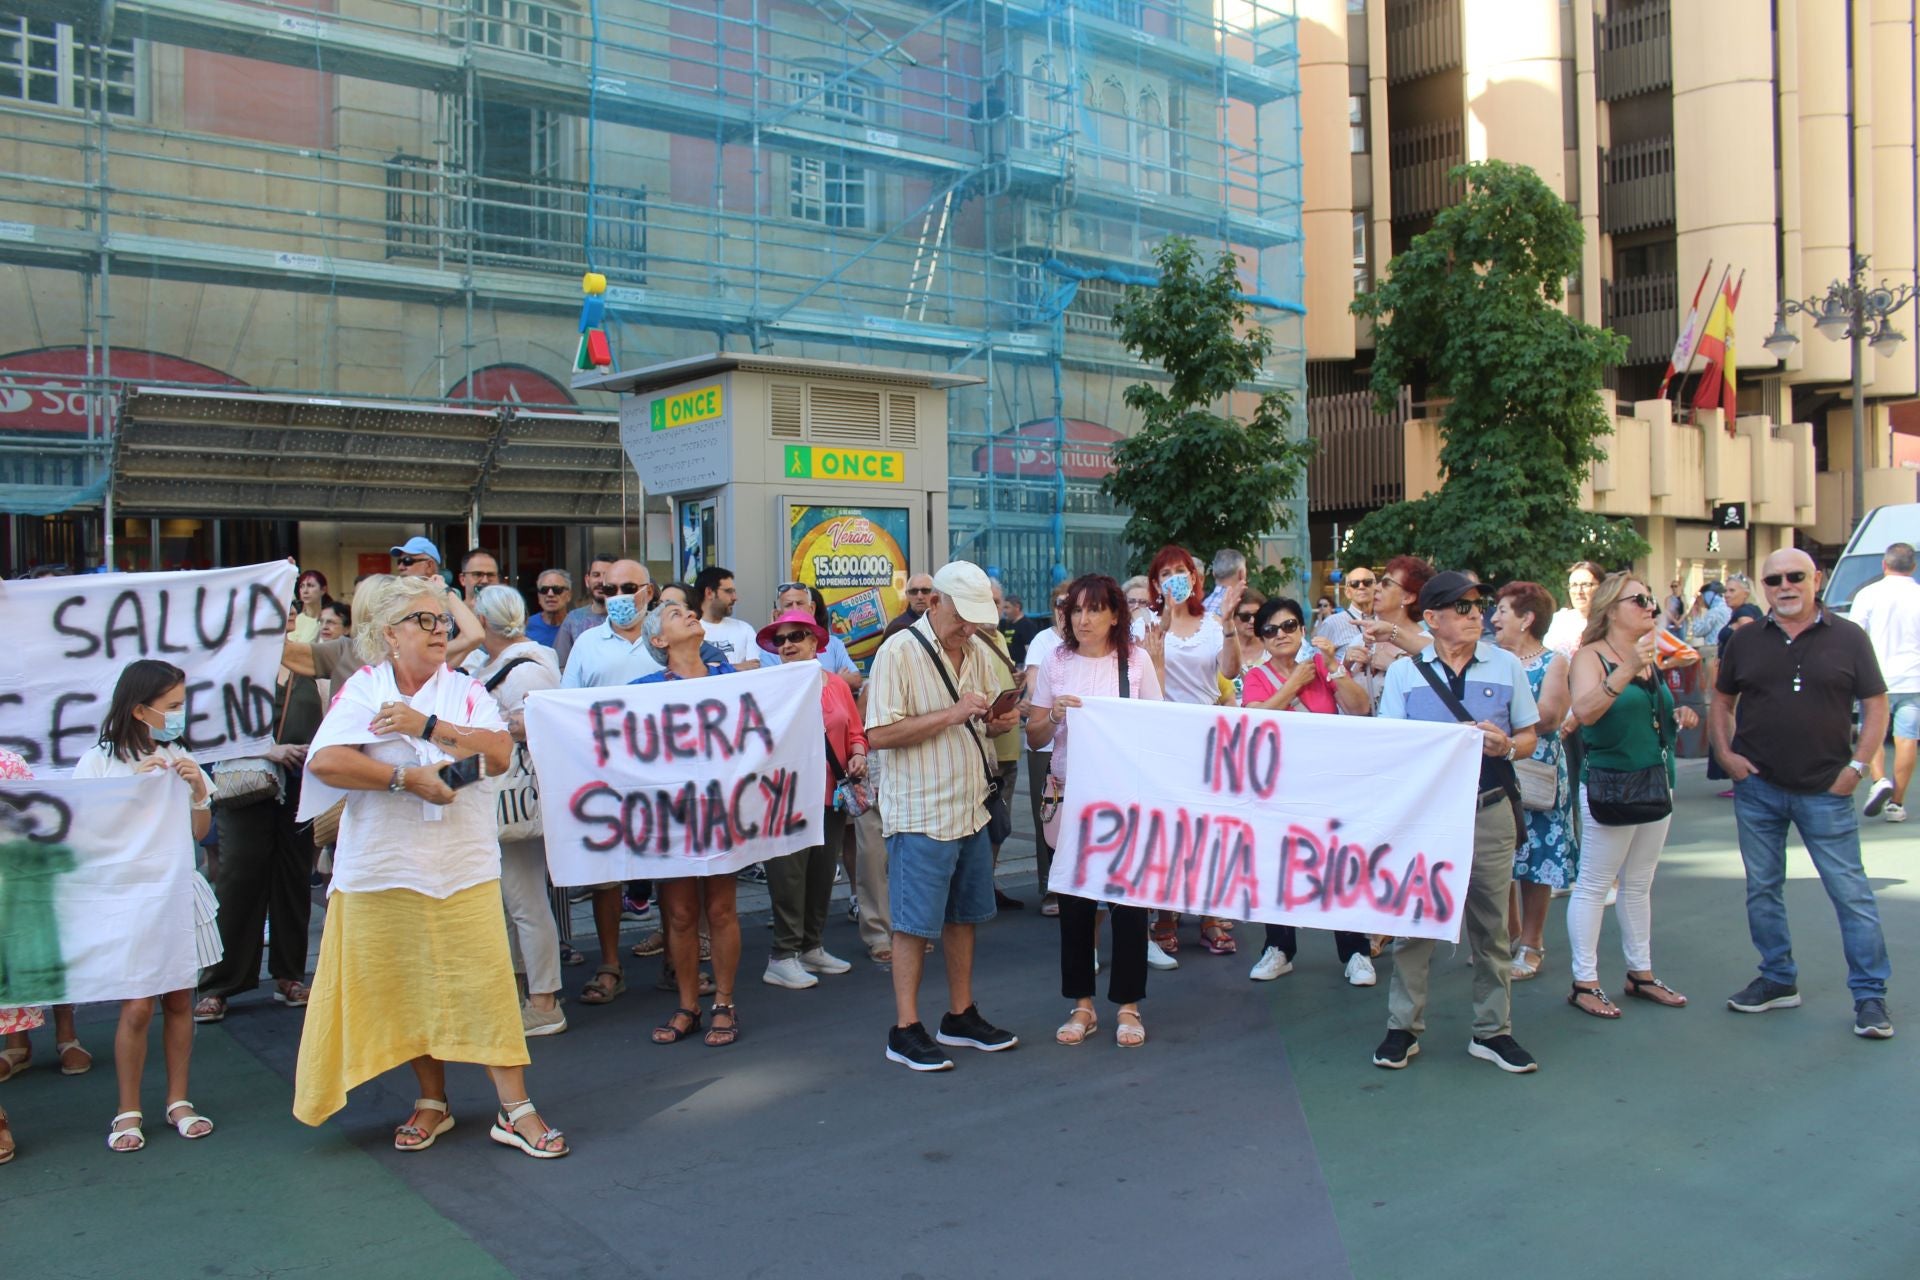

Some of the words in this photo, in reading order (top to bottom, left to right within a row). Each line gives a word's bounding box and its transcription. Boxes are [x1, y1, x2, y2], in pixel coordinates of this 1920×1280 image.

[671, 390, 717, 422] ONCE
[821, 453, 895, 478] ONCE
[826, 518, 876, 551] Verano
[826, 578, 851, 587] PREMIOS
[53, 583, 287, 659] SALUD
[184, 676, 276, 748] END
[589, 691, 775, 767] FUERA
[1203, 714, 1282, 800] NO
[569, 767, 808, 856] SOMACYL
[1072, 800, 1260, 920] PLANTA
